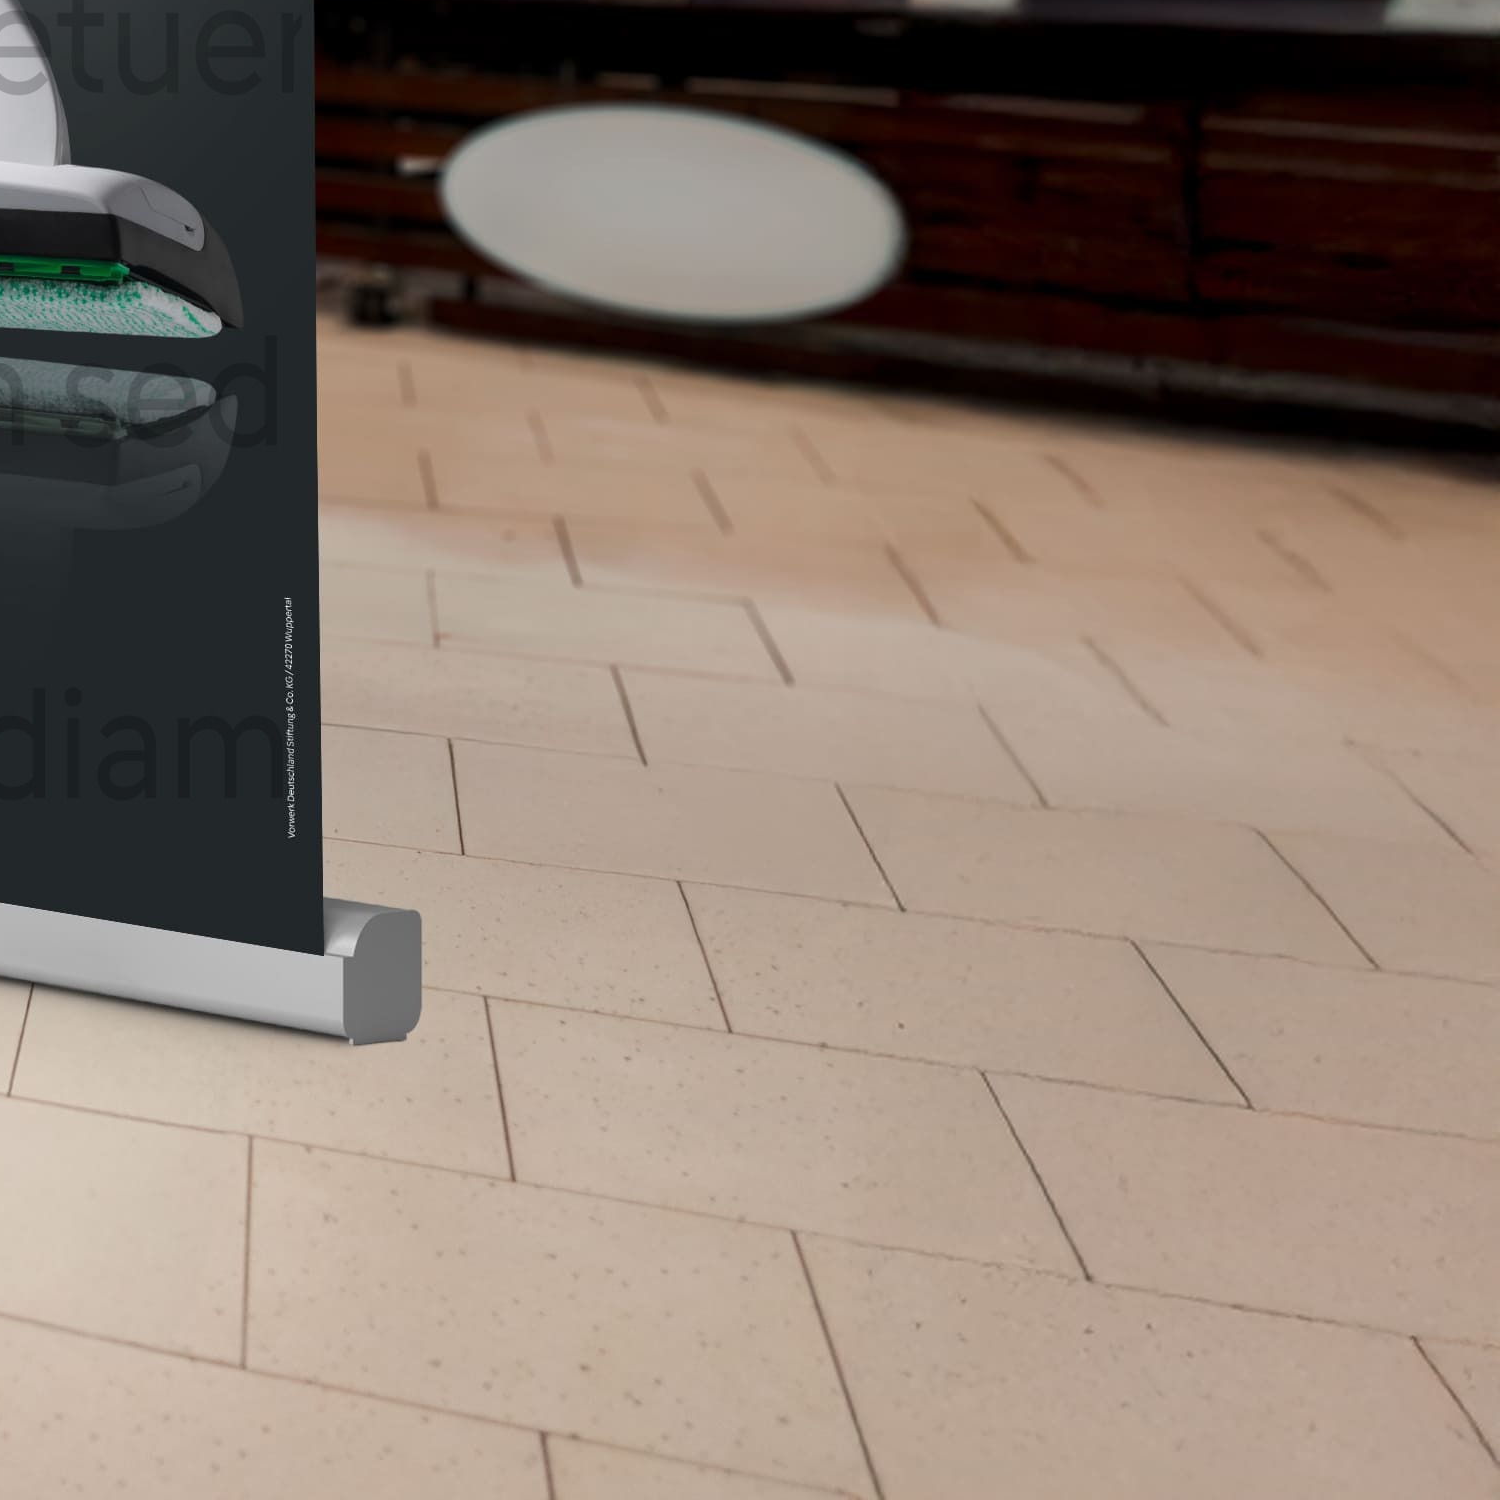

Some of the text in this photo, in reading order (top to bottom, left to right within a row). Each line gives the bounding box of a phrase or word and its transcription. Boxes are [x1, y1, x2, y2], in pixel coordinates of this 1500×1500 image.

[283, 598, 294, 642] Wuppertal
[284, 642, 293, 670] 42270
[285, 676, 293, 689] KG
[285, 690, 294, 705] Co.
[286, 712, 296, 747] Stiftung
[286, 748, 296, 802] Deutschland
[286, 803, 297, 839] Vorwerk
